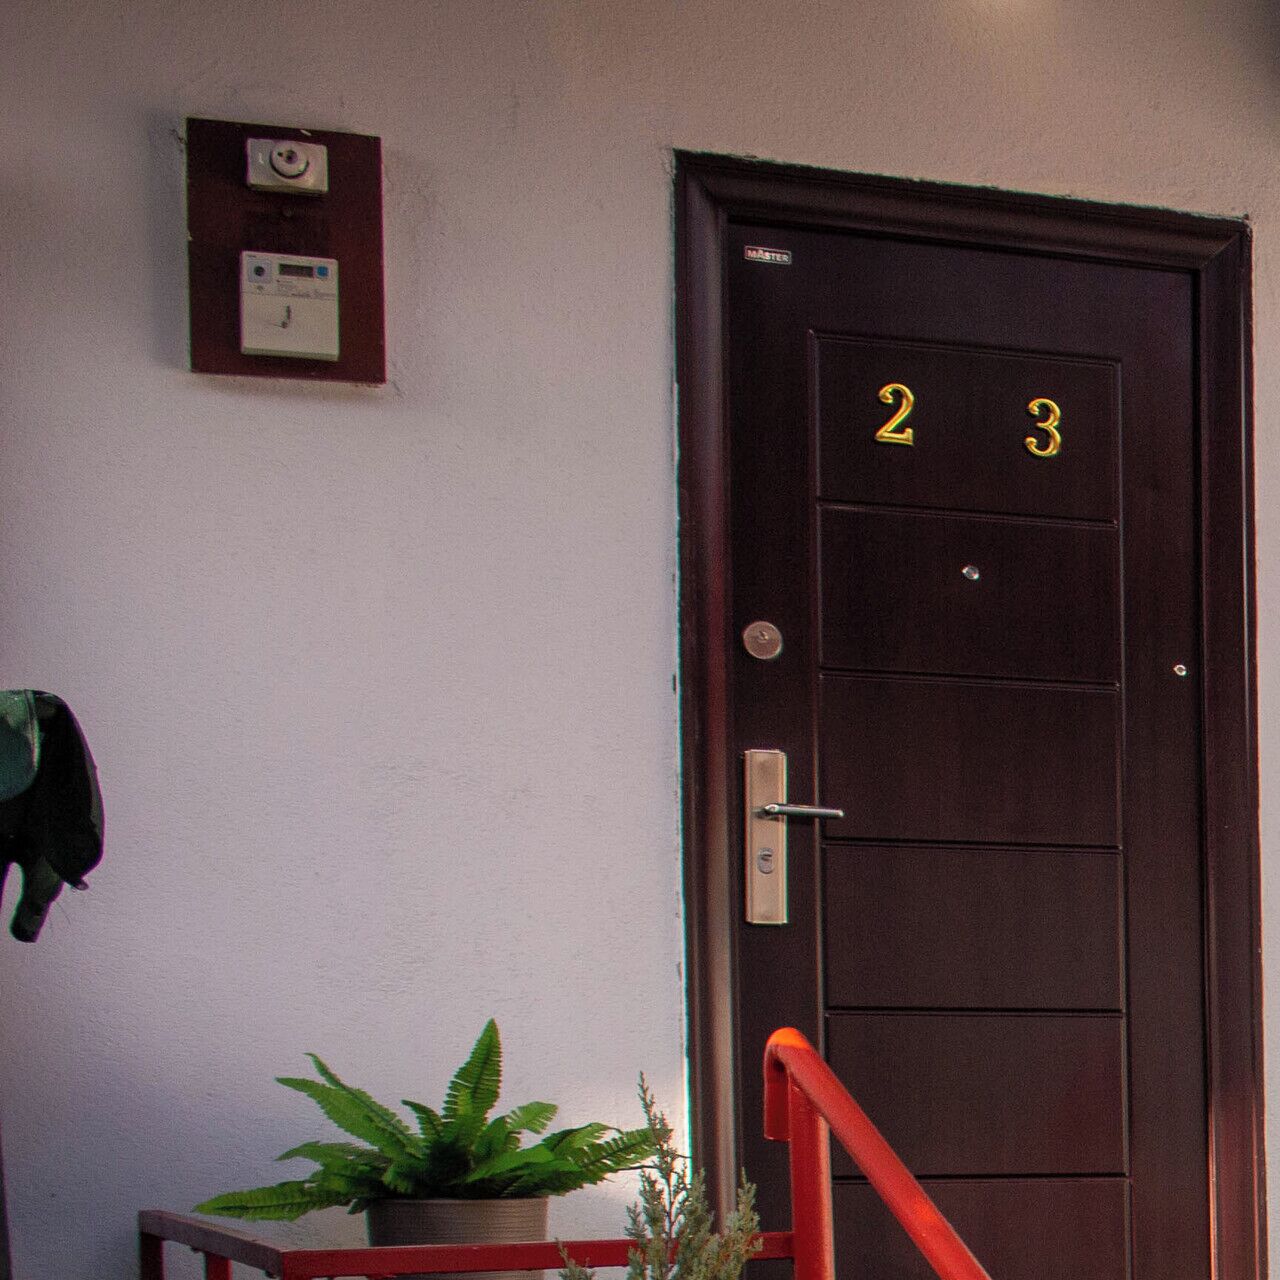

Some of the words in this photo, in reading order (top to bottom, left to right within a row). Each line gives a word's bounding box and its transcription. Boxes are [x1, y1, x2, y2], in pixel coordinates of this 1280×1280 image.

[747, 249, 789, 262] MASTER
[875, 383, 914, 446] 2
[1025, 398, 1061, 456] 3
